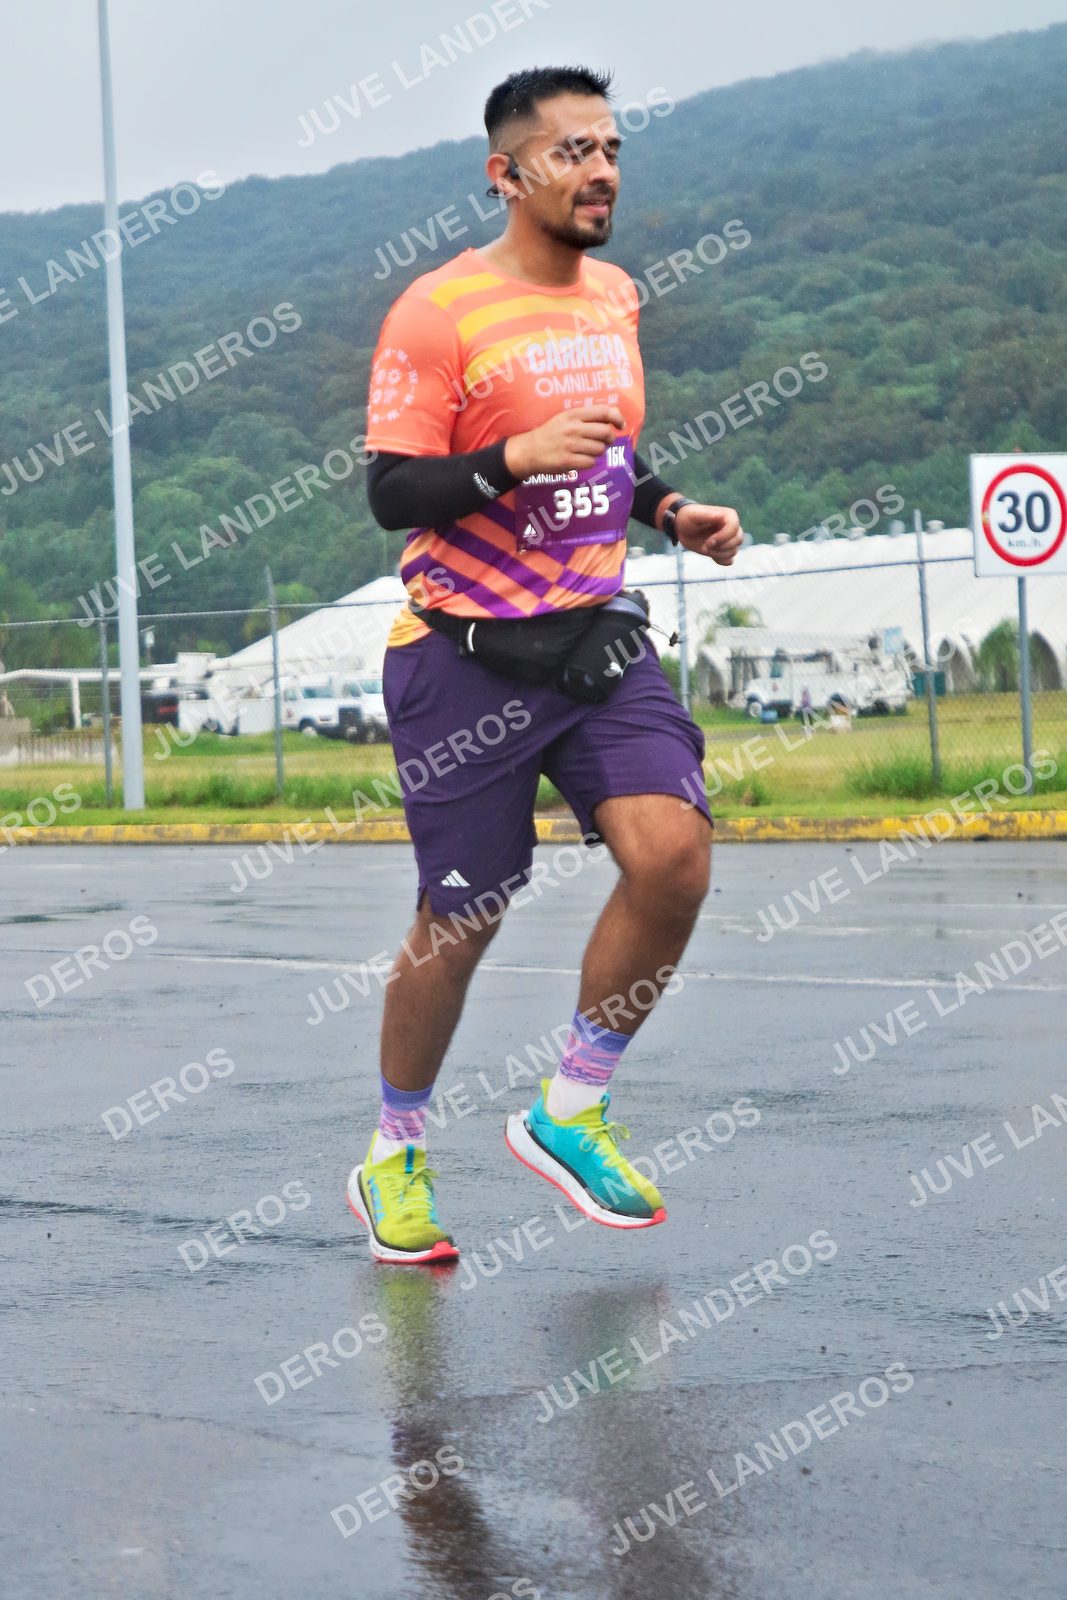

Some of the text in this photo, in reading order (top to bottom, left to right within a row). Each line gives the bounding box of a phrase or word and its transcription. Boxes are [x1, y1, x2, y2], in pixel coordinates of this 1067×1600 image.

[528, 333, 629, 374] CARRERA
[535, 369, 614, 397] OMNILIFE
[606, 445, 626, 468] 16K
[553, 484, 611, 520] 355
[997, 490, 1051, 533] 30
